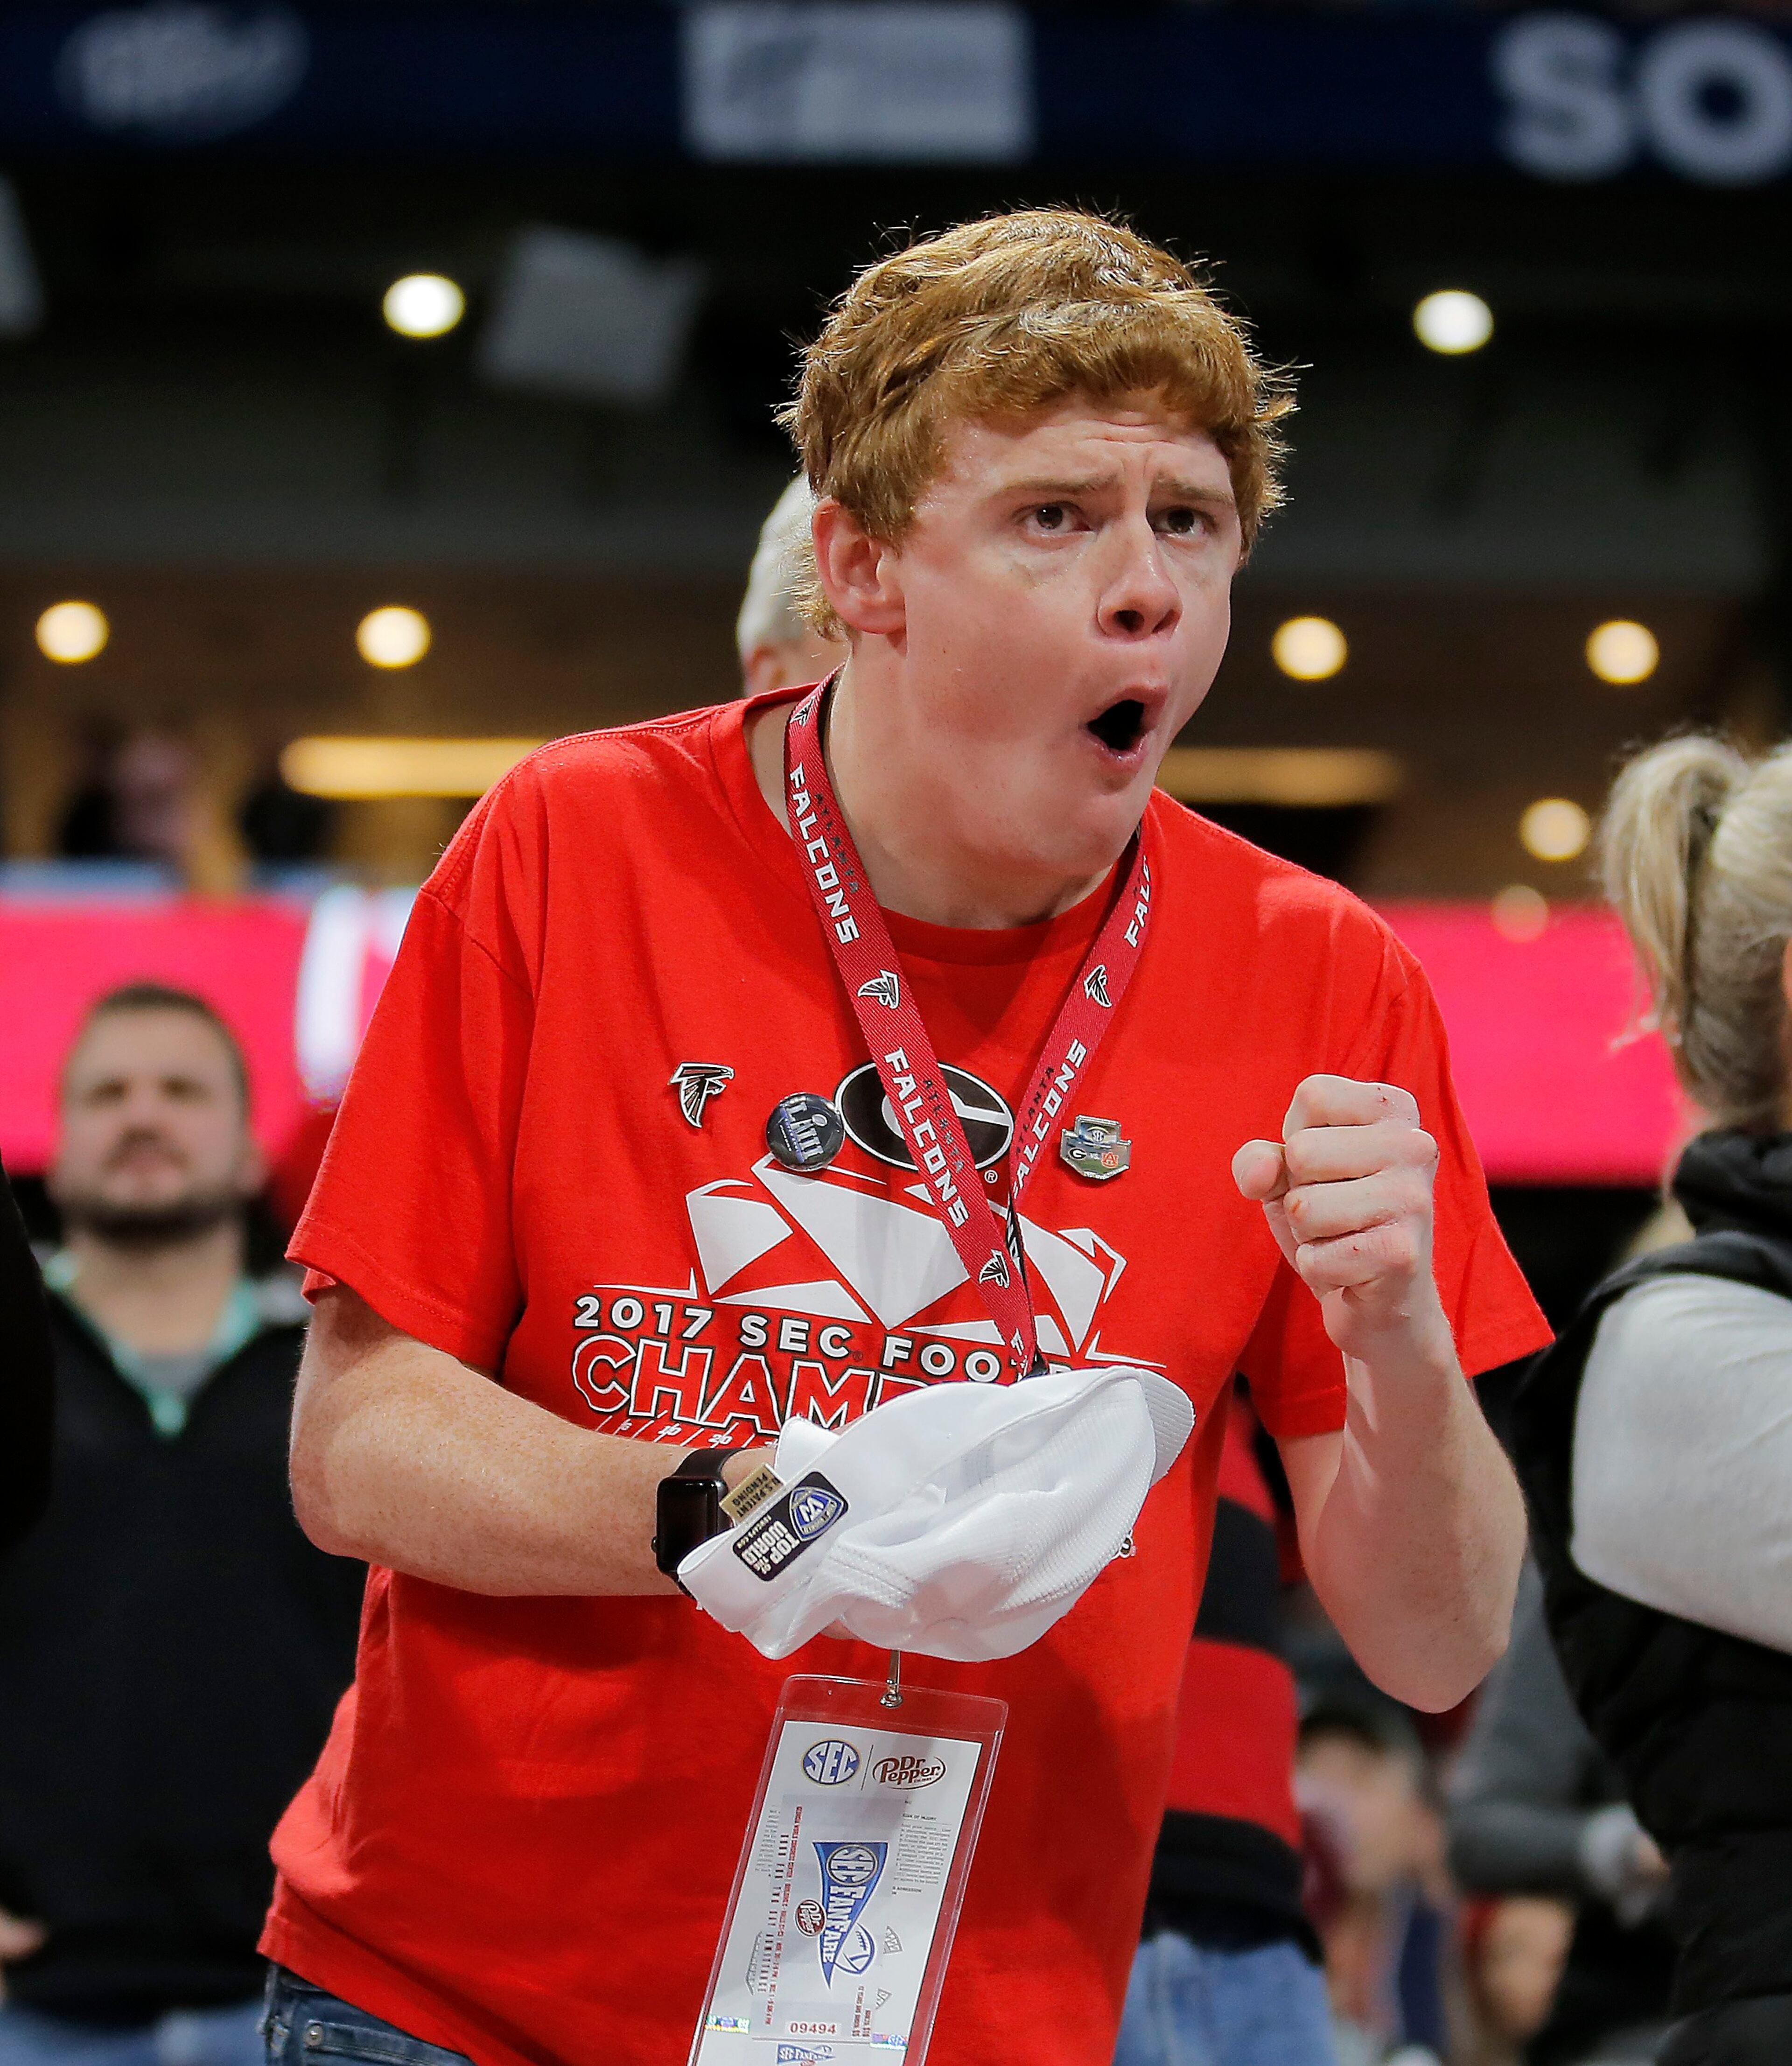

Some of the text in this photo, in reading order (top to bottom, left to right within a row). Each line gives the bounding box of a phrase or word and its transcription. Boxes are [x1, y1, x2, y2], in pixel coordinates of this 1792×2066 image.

[789, 761, 860, 945] FALCONS
[884, 1046, 970, 1228] FALCONS
[574, 1295, 713, 1339] 2017
[740, 1314, 852, 1358] SEC
[732, 1472, 769, 1506] PENDING
[741, 1520, 788, 1565] WORLD
[770, 1532, 800, 1564] TOP
[804, 1741, 859, 1785] SEC
[879, 1757, 941, 1785] Pepper
[900, 1756, 926, 1771] Dr
[830, 1846, 875, 1884] SEC
[823, 1885, 866, 1964] FANFARE
[789, 2022, 837, 2035] 09494
